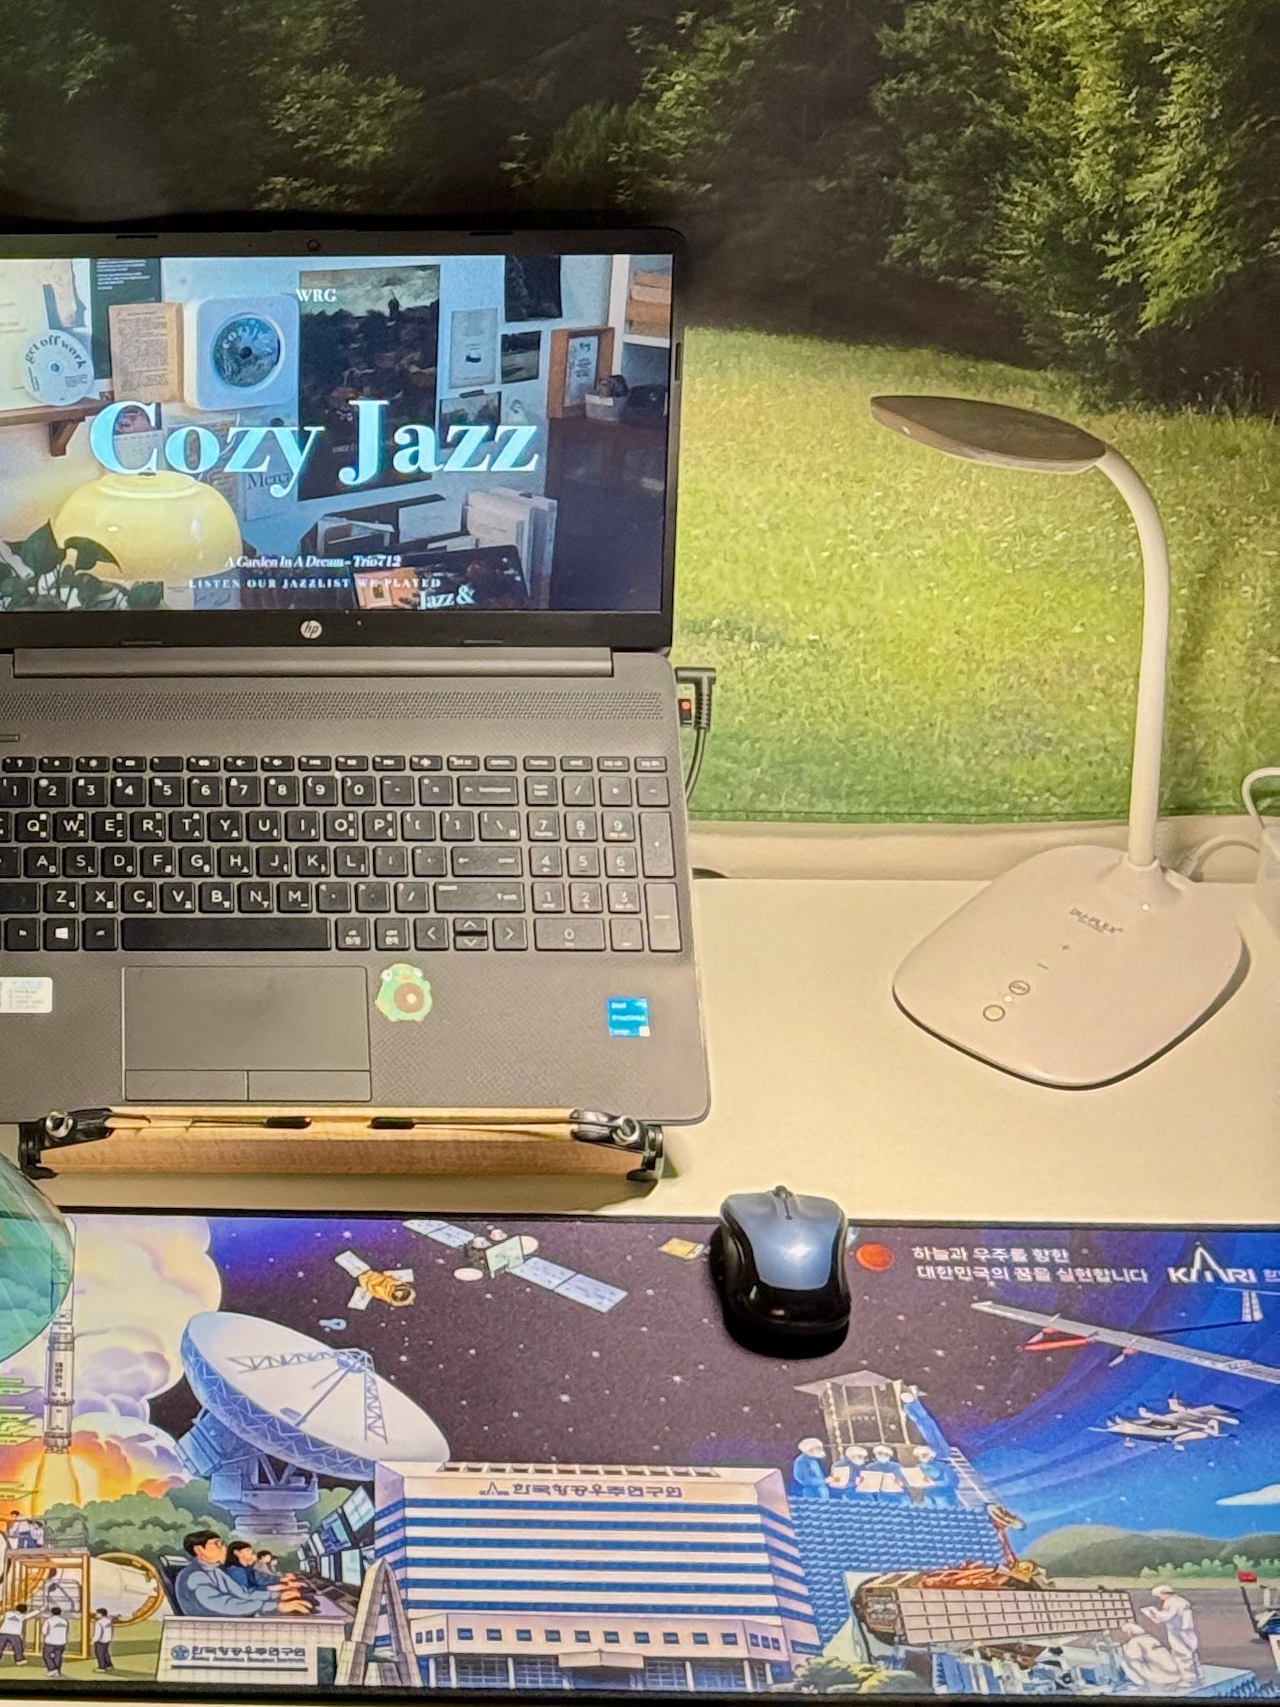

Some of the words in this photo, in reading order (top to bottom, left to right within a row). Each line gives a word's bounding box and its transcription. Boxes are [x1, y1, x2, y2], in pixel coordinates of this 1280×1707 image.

[89, 399, 325, 498] Cozy
[338, 399, 540, 486] Jazz
[236, 555, 279, 569] Garden
[352, 554, 402, 568] Trio712
[188, 578, 241, 589] LISTEN
[246, 578, 277, 588] OUR
[282, 578, 351, 588] JAZZLIST
[384, 578, 442, 588] PLAYED
[48, 785, 57, 796] 2
[86, 785, 96, 796] 3
[124, 784, 134, 796] 4
[163, 784, 172, 795] 5
[201, 784, 210, 795] 6
[239, 784, 249, 796] 7
[277, 784, 287, 796] 8
[315, 784, 326, 796] 9
[353, 784, 364, 795] 0
[26, 819, 40, 833] Q
[63, 819, 79, 832] W
[105, 819, 115, 832] E
[142, 819, 154, 832] R
[182, 818, 192, 832] T
[220, 819, 231, 831] Y
[258, 819, 270, 831] U
[334, 819, 348, 832] O
[374, 818, 385, 831] P
[36, 854, 48, 867] A
[76, 854, 86, 867] S
[114, 854, 125, 867] D
[153, 854, 163, 866] F
[190, 854, 203, 867] G
[230, 854, 241, 867] H
[270, 854, 279, 867] J
[308, 854, 318, 866] K
[347, 854, 356, 867] L
[56, 890, 67, 903] Z
[95, 890, 106, 902] X
[133, 890, 146, 903] C
[171, 889, 184, 903] V
[211, 890, 222, 902] B
[250, 890, 262, 902] N
[288, 890, 301, 902] M
[912, 1246, 967, 1263] 하늘과
[972, 1247, 1028, 1263] 우주를
[1031, 1247, 1070, 1264] 향한
[916, 1265, 1009, 1282] 대한민국의
[1015, 1267, 1052, 1283] 꿈을
[1058, 1266, 1149, 1284] 실현합니다
